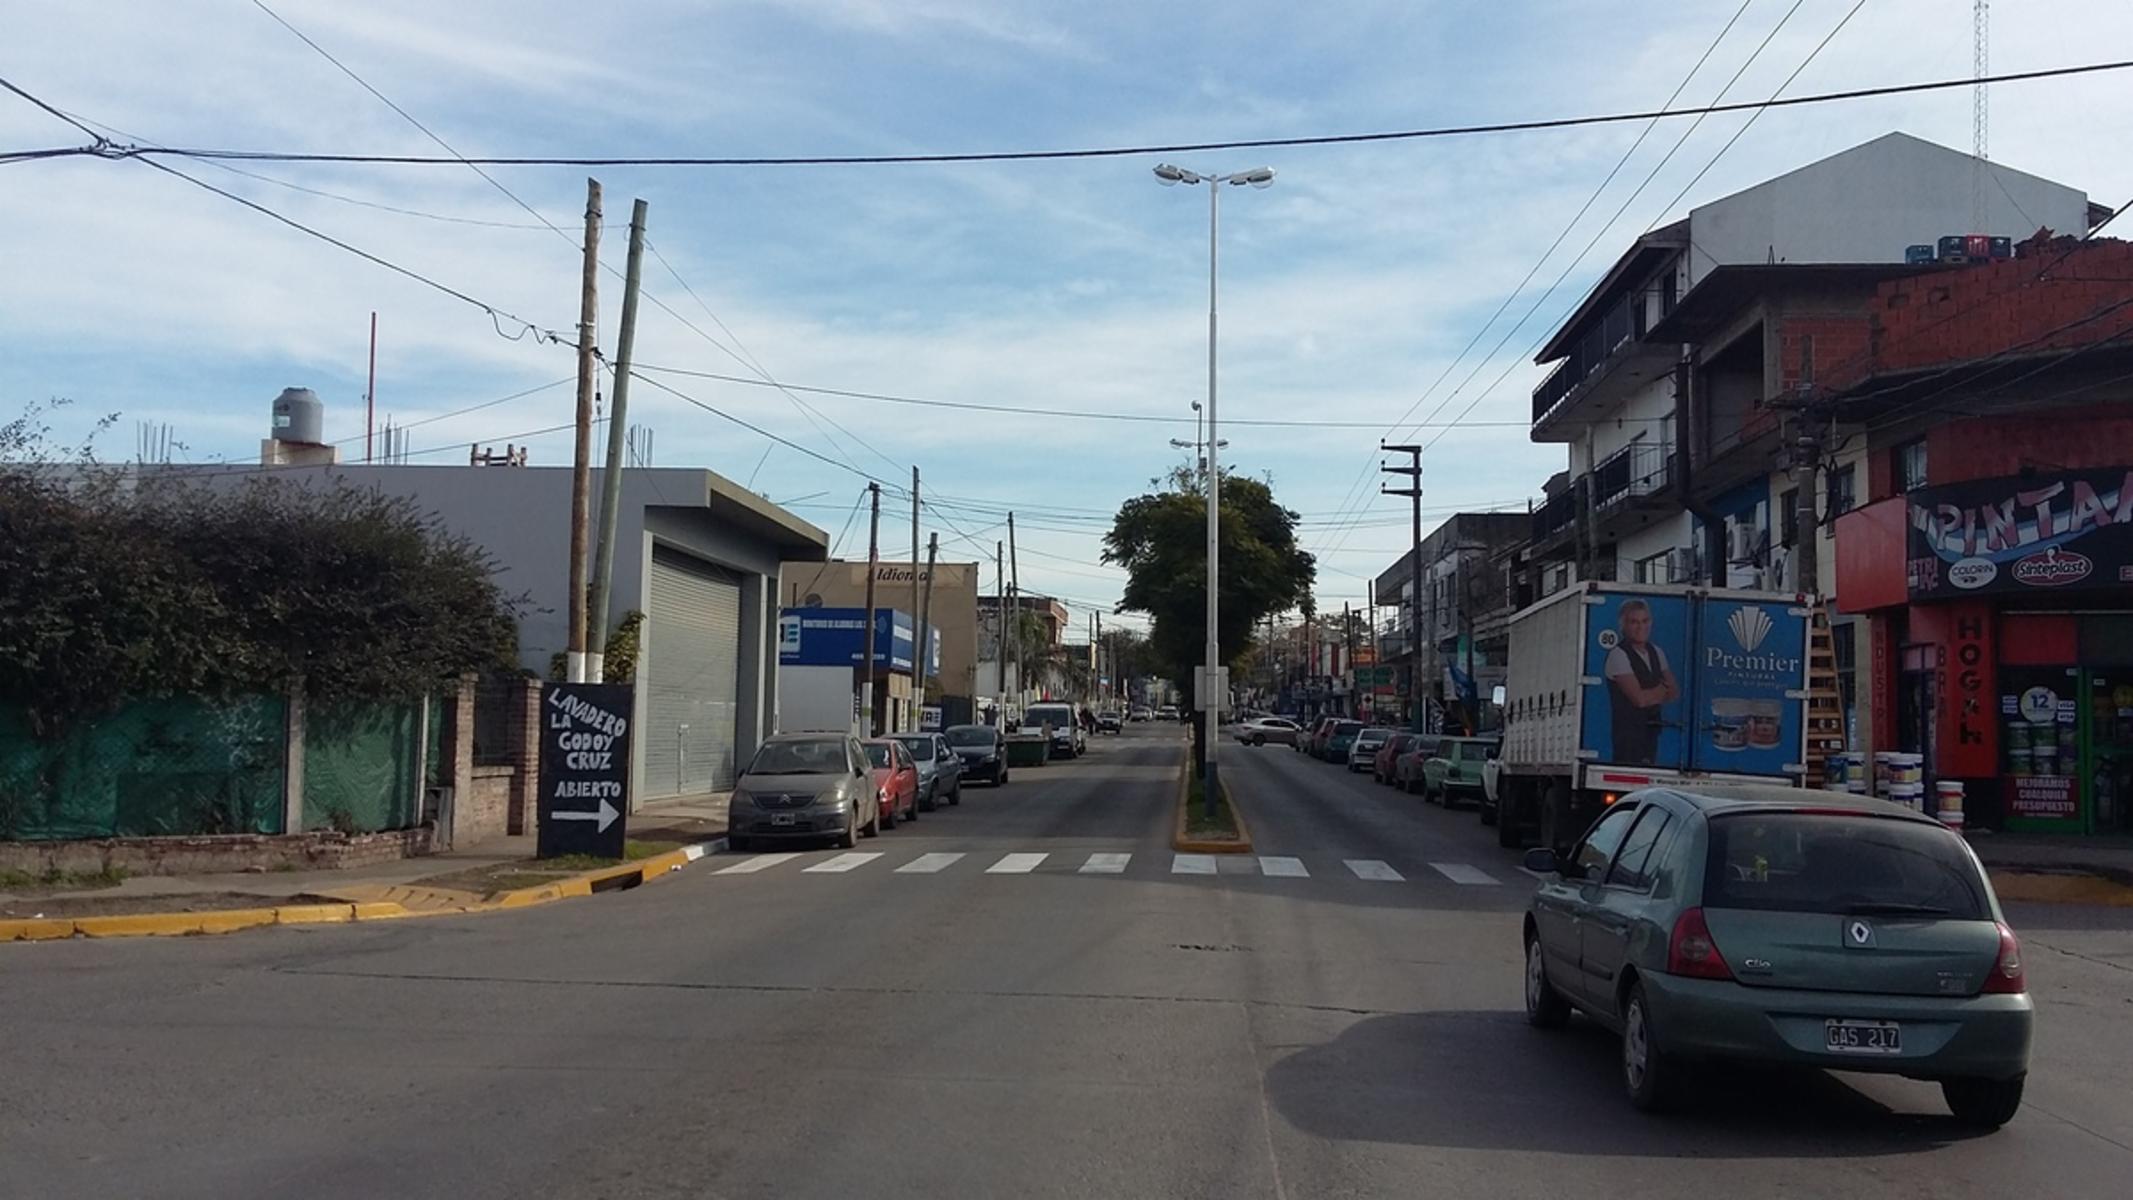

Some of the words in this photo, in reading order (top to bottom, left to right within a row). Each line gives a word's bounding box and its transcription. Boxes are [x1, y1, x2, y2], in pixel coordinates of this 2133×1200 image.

[876, 568, 935, 581] Idioma
[1951, 564, 1993, 576] COLORIN
[2018, 560, 2087, 579] Sinteplast
[1601, 632, 1615, 645] 80
[1706, 646, 1799, 673] Premier
[2031, 694, 2049, 708] 12
[548, 688, 627, 737] LAVADERO
[551, 713, 571, 729] LA
[558, 731, 614, 752] GODOY
[566, 752, 613, 770] CRUZ
[554, 781, 622, 798] ABIERTO
[2015, 777, 2071, 789] MEJORAMOS
[2018, 789, 2068, 800] CUALQUIER
[2012, 800, 2075, 812] PRESUPUESTO
[1829, 1027, 1858, 1046] GAS
[1868, 1028, 1897, 1047] 217
